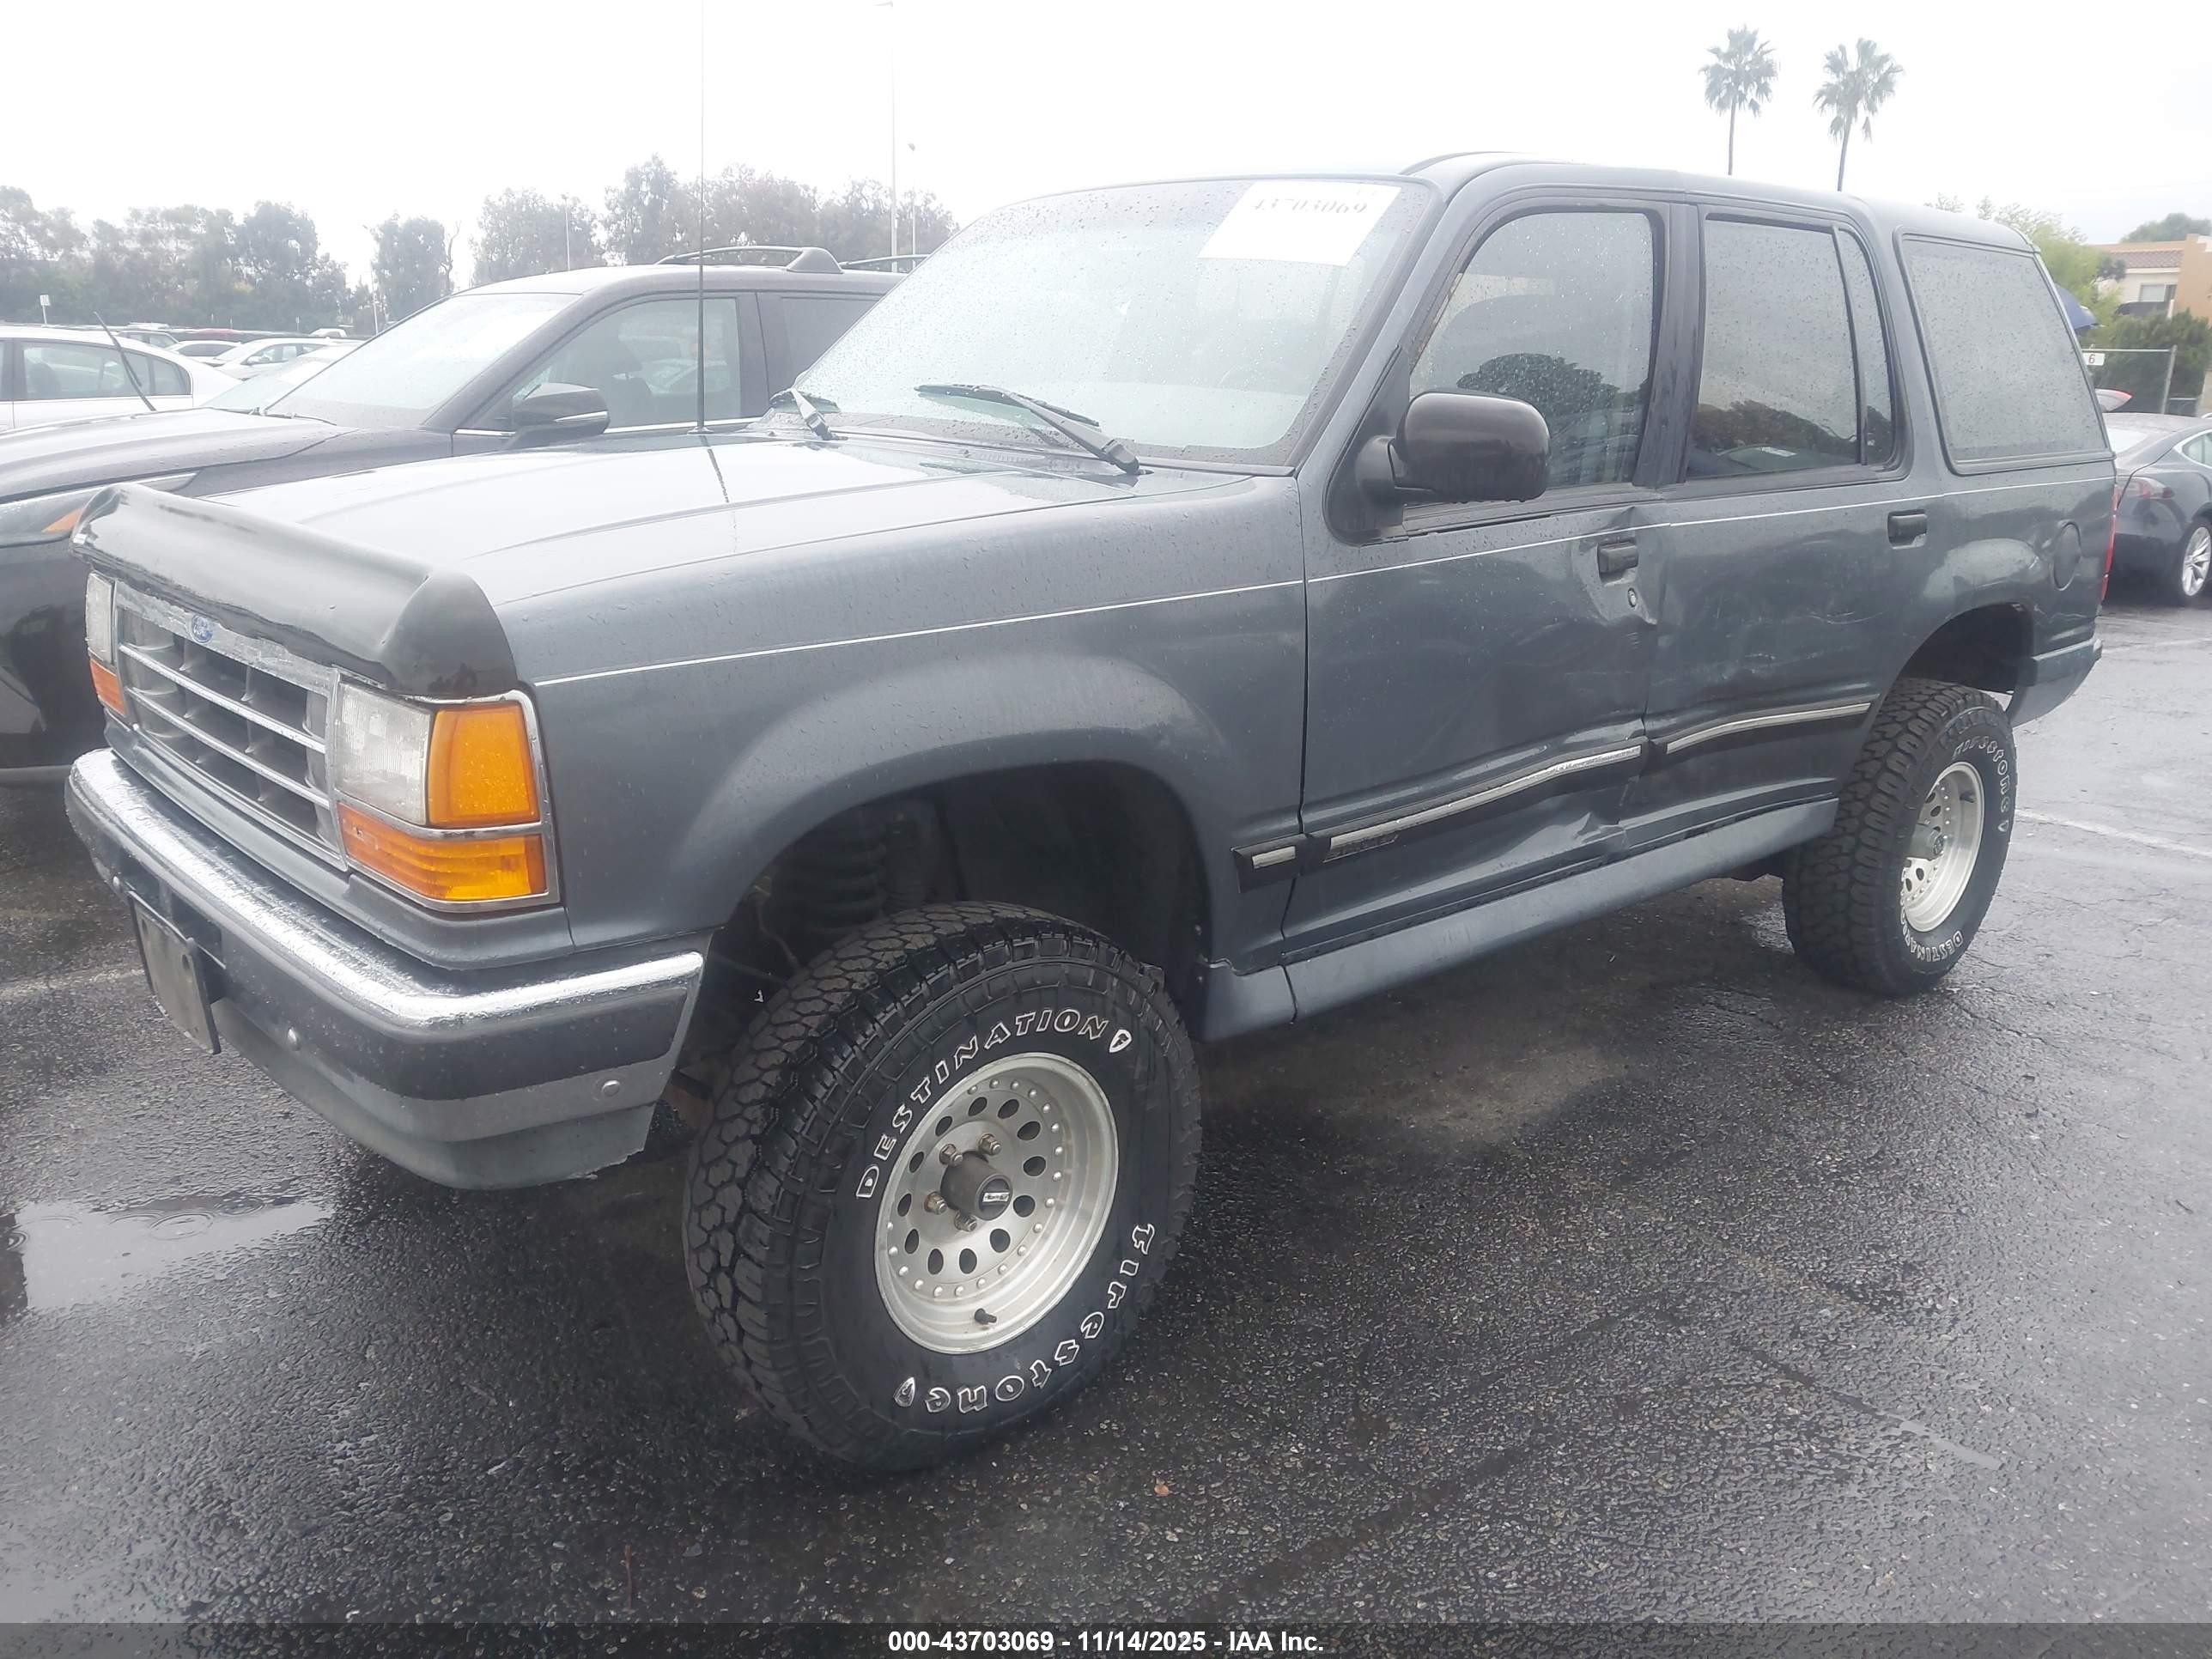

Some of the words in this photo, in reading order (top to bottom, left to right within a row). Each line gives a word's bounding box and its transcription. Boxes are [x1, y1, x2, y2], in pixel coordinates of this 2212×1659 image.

[2088, 353, 2096, 364] 6
[855, 1008, 1109, 1200] DESTINATION
[924, 1222, 1156, 1414] Firestone
